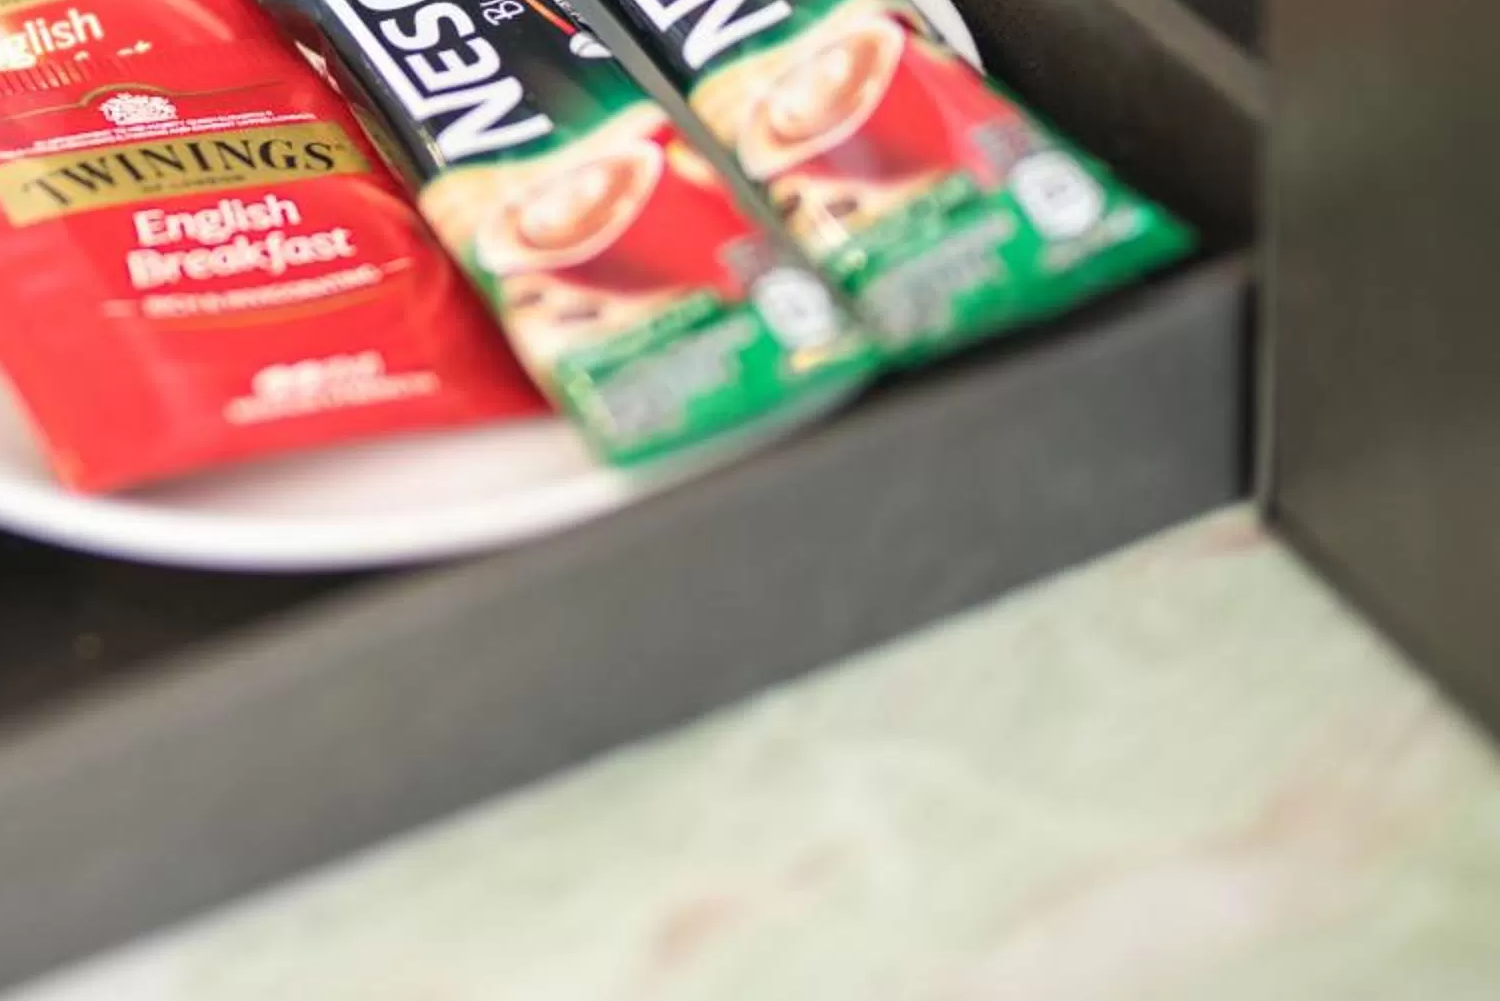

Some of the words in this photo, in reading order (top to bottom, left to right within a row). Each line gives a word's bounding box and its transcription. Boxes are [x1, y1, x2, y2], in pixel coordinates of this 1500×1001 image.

[21, 138, 335, 208] TWININGS
[133, 194, 302, 249] English
[126, 224, 355, 290] Breakfast
